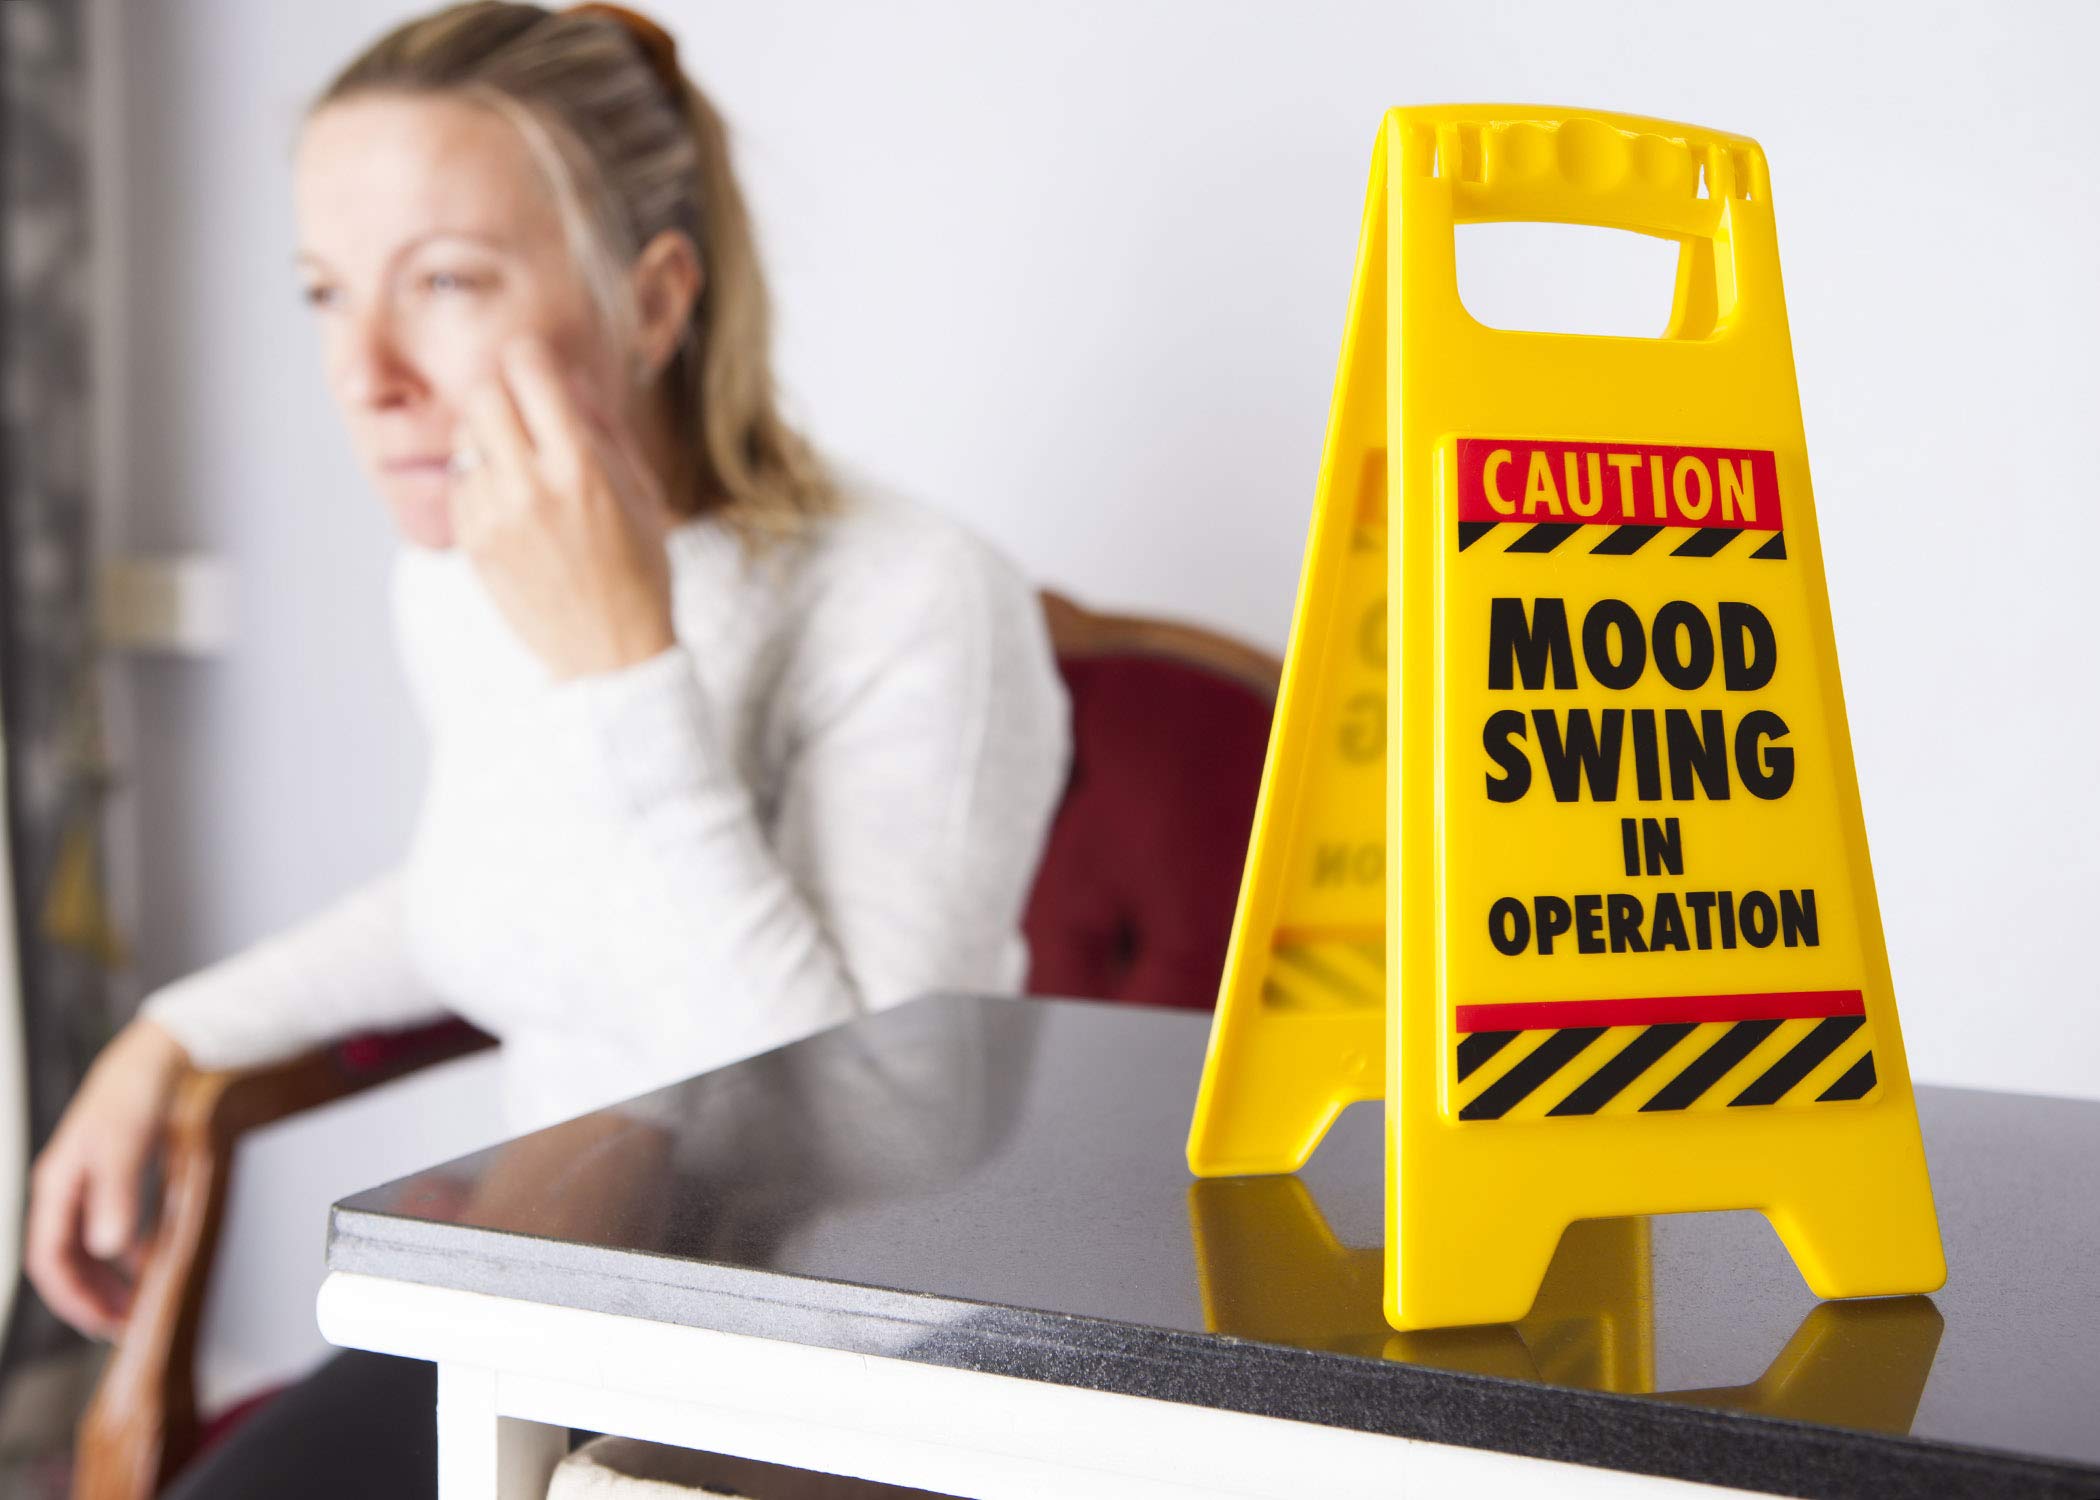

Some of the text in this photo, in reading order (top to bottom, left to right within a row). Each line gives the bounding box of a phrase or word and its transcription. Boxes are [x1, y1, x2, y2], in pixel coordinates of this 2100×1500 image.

[1483, 449, 1758, 522] CAUTION
[1488, 597, 1777, 691] MOOD
[1483, 709, 1795, 803] SWING
[1621, 817, 1684, 877] IN
[1488, 889, 1820, 956] OPERATION
